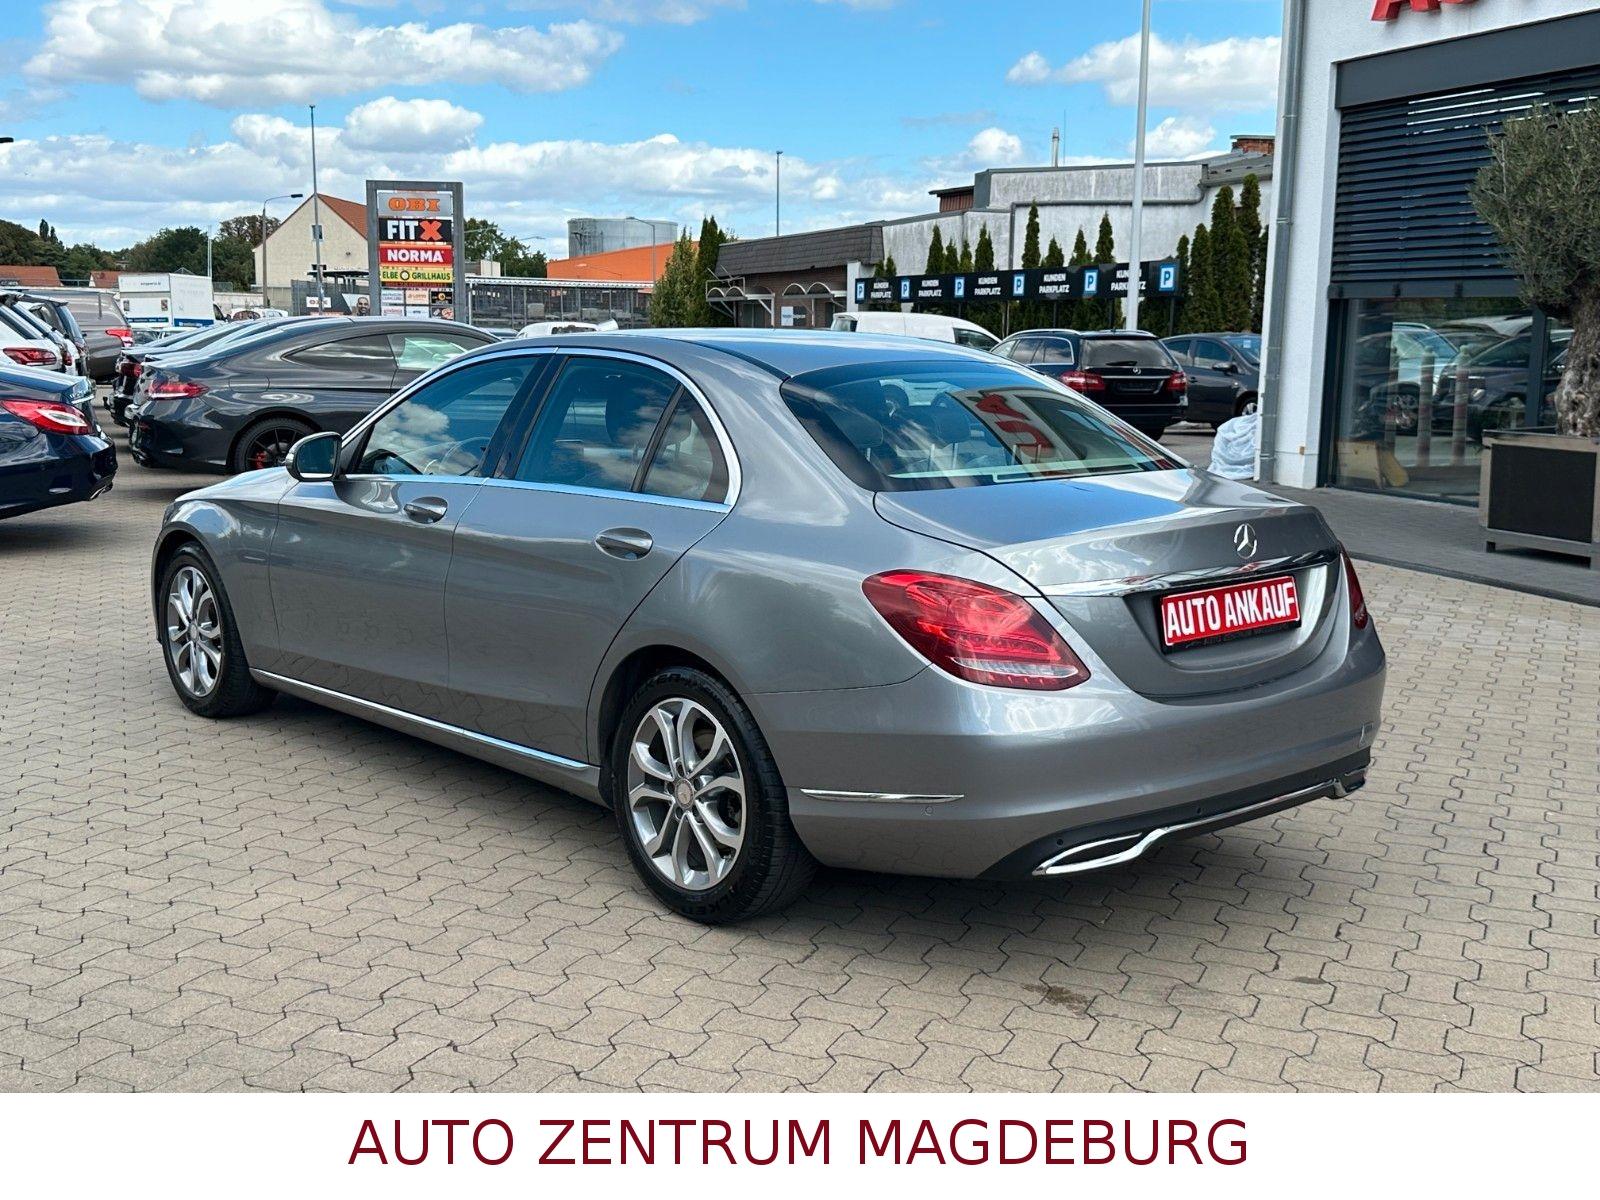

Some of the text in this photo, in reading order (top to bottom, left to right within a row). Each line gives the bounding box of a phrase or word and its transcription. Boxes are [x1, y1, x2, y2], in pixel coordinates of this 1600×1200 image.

[388, 197, 440, 211] OBI
[387, 249, 444, 262] NORMA
[382, 271, 451, 280] ELBE GRILLHAUS
[1043, 273, 1067, 282] KUNDEN
[1038, 284, 1070, 294] PARKPLATZ
[1167, 594, 1221, 639] AUTO
[1223, 581, 1295, 628] ANKAUF
